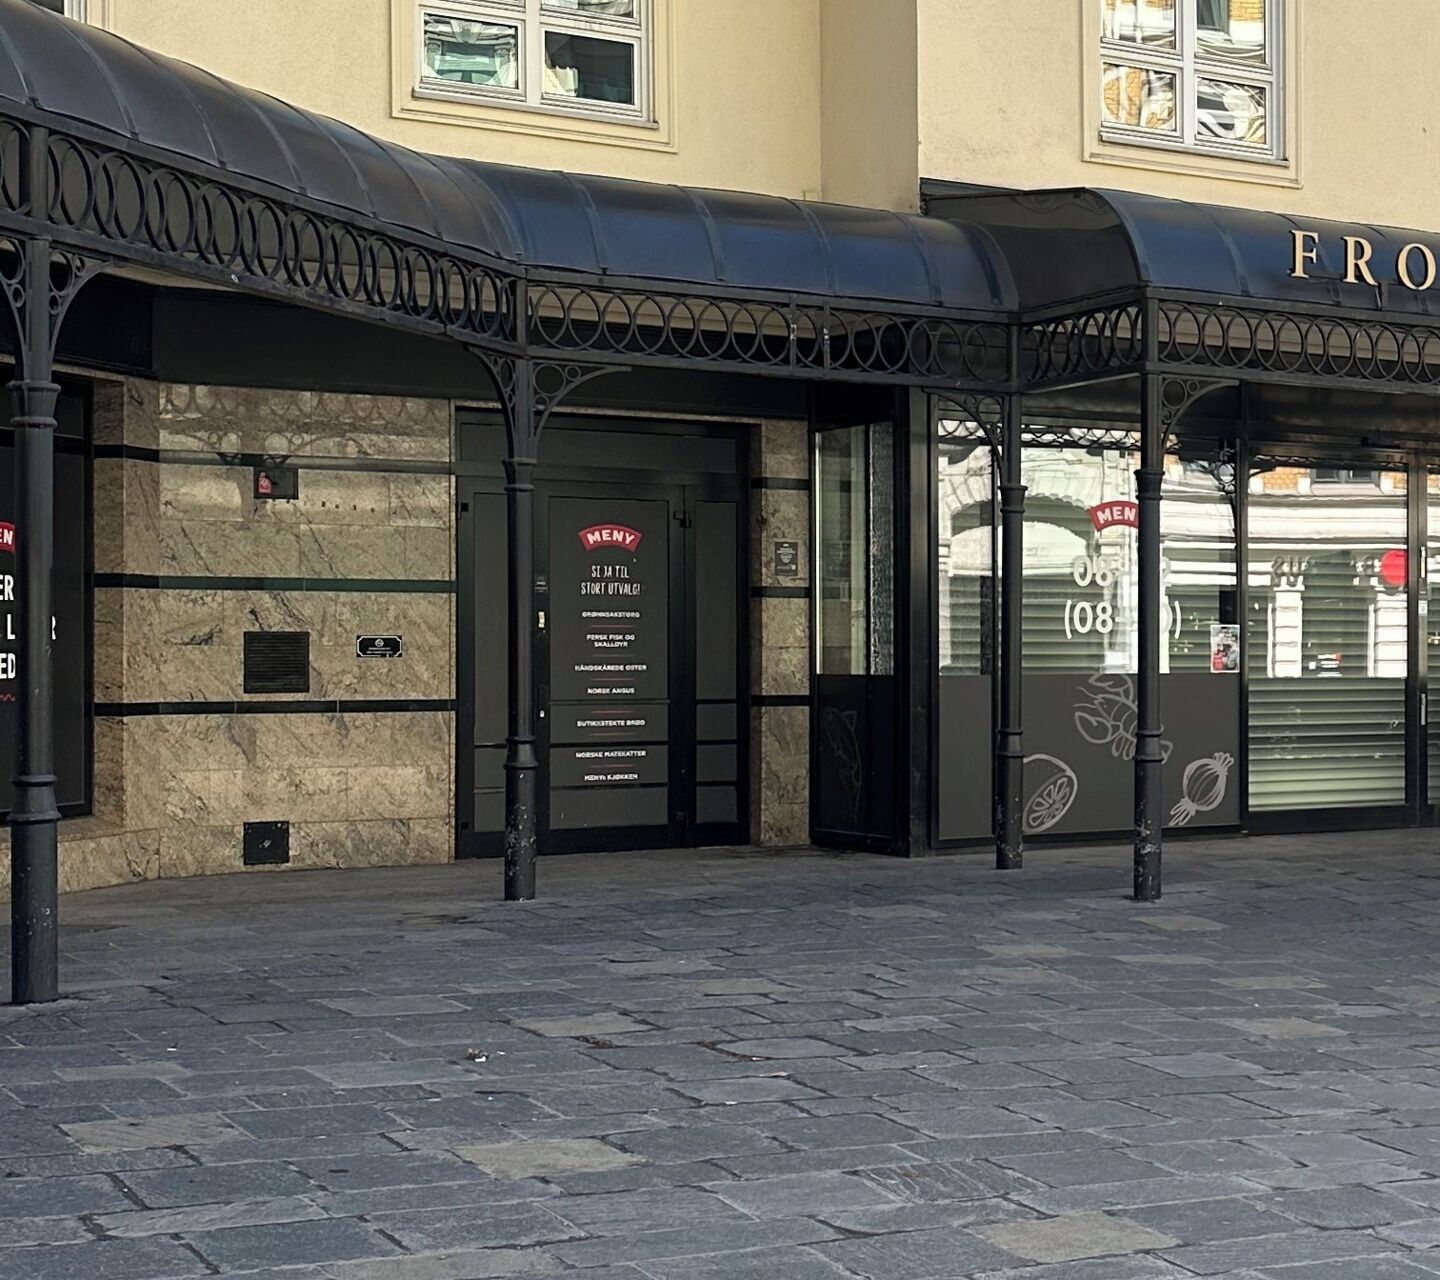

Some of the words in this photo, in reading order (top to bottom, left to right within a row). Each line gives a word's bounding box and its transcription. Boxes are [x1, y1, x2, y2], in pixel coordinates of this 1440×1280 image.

[1097, 506, 1136, 524] MEN
[586, 529, 635, 545] MENY
[591, 565, 601, 578] SI
[603, 565, 613, 578] JA
[615, 565, 630, 578] TIL
[581, 582, 606, 595] STORT
[608, 582, 641, 596] UTVALG!
